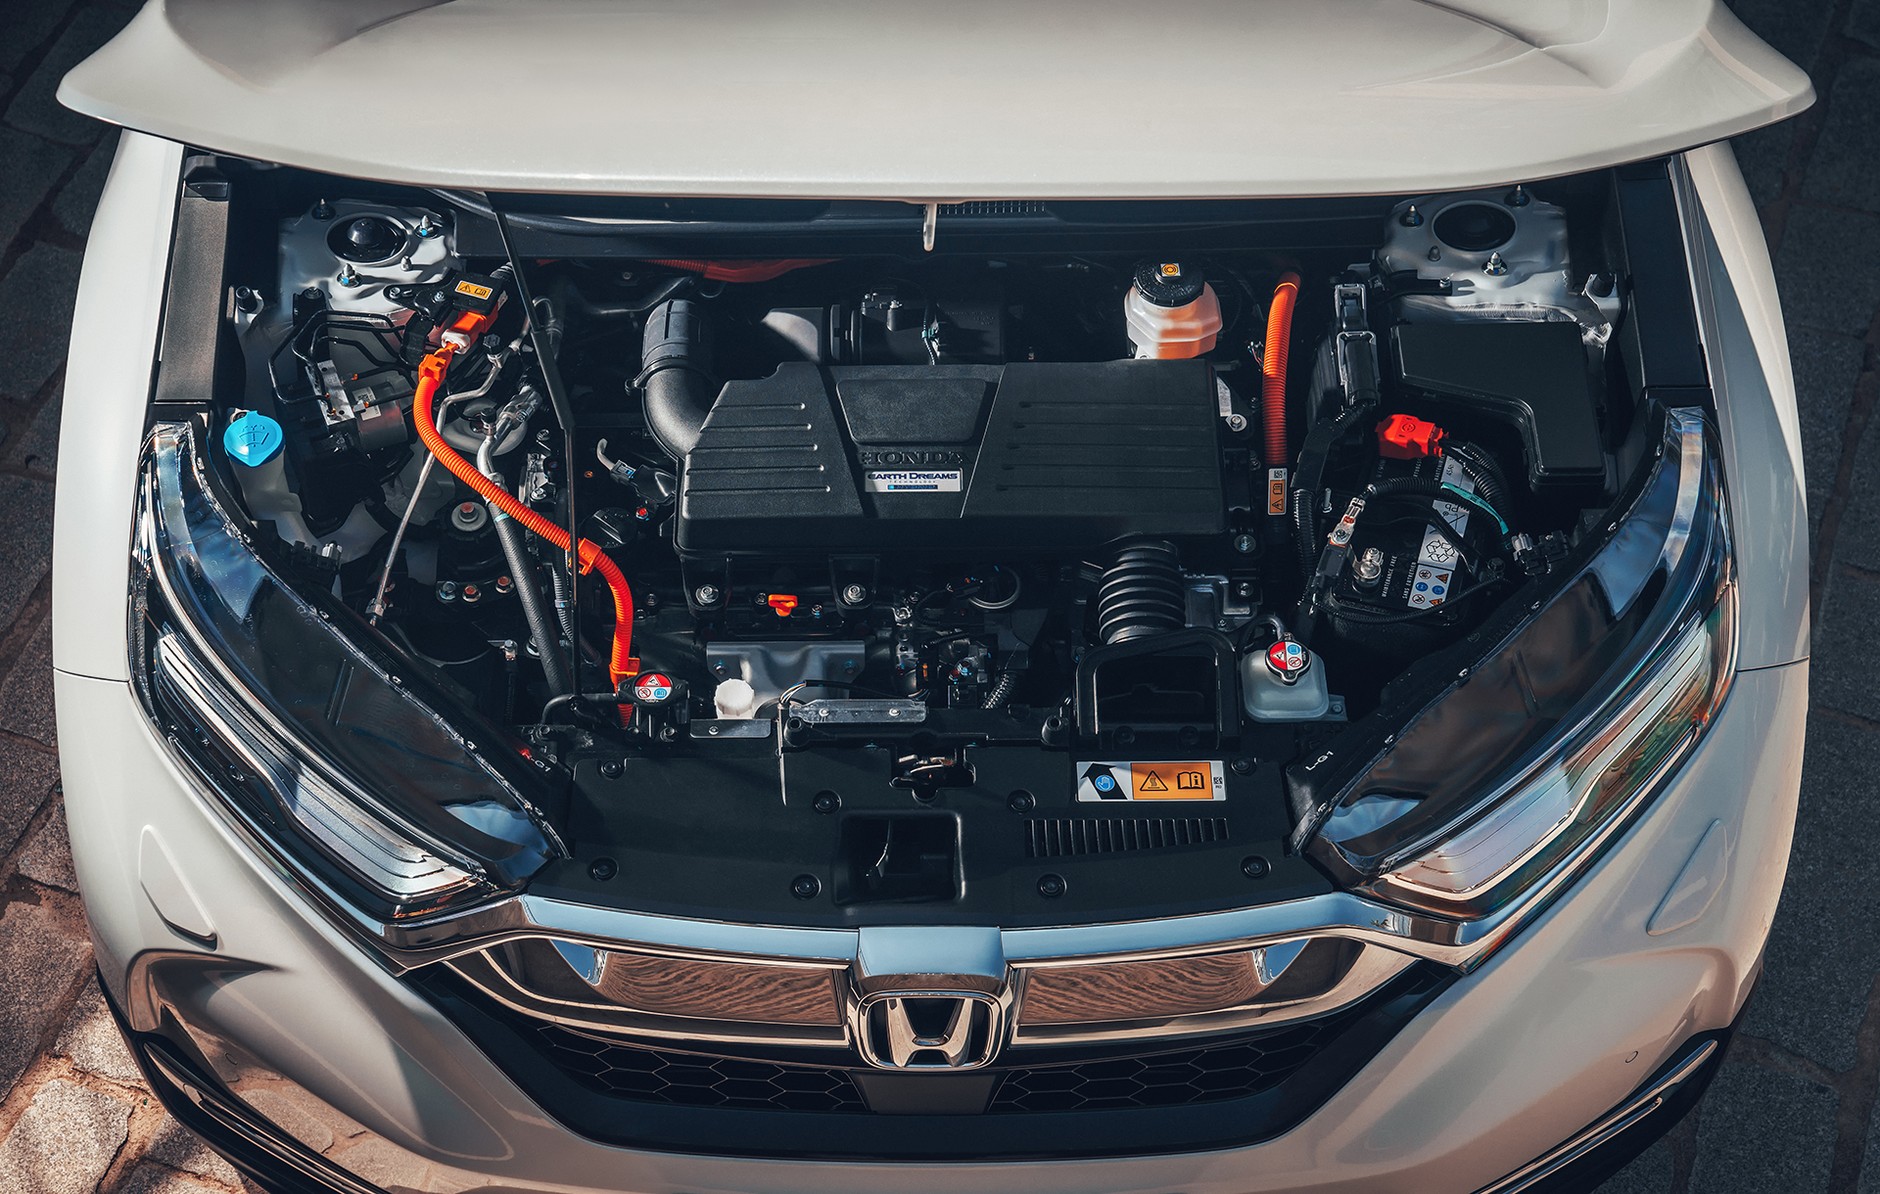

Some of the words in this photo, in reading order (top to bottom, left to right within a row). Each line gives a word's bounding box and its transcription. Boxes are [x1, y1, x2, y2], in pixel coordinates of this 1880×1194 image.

[861, 450, 972, 465] HONDA
[867, 472, 907, 480] EARTH
[909, 472, 958, 480] DREAMS
